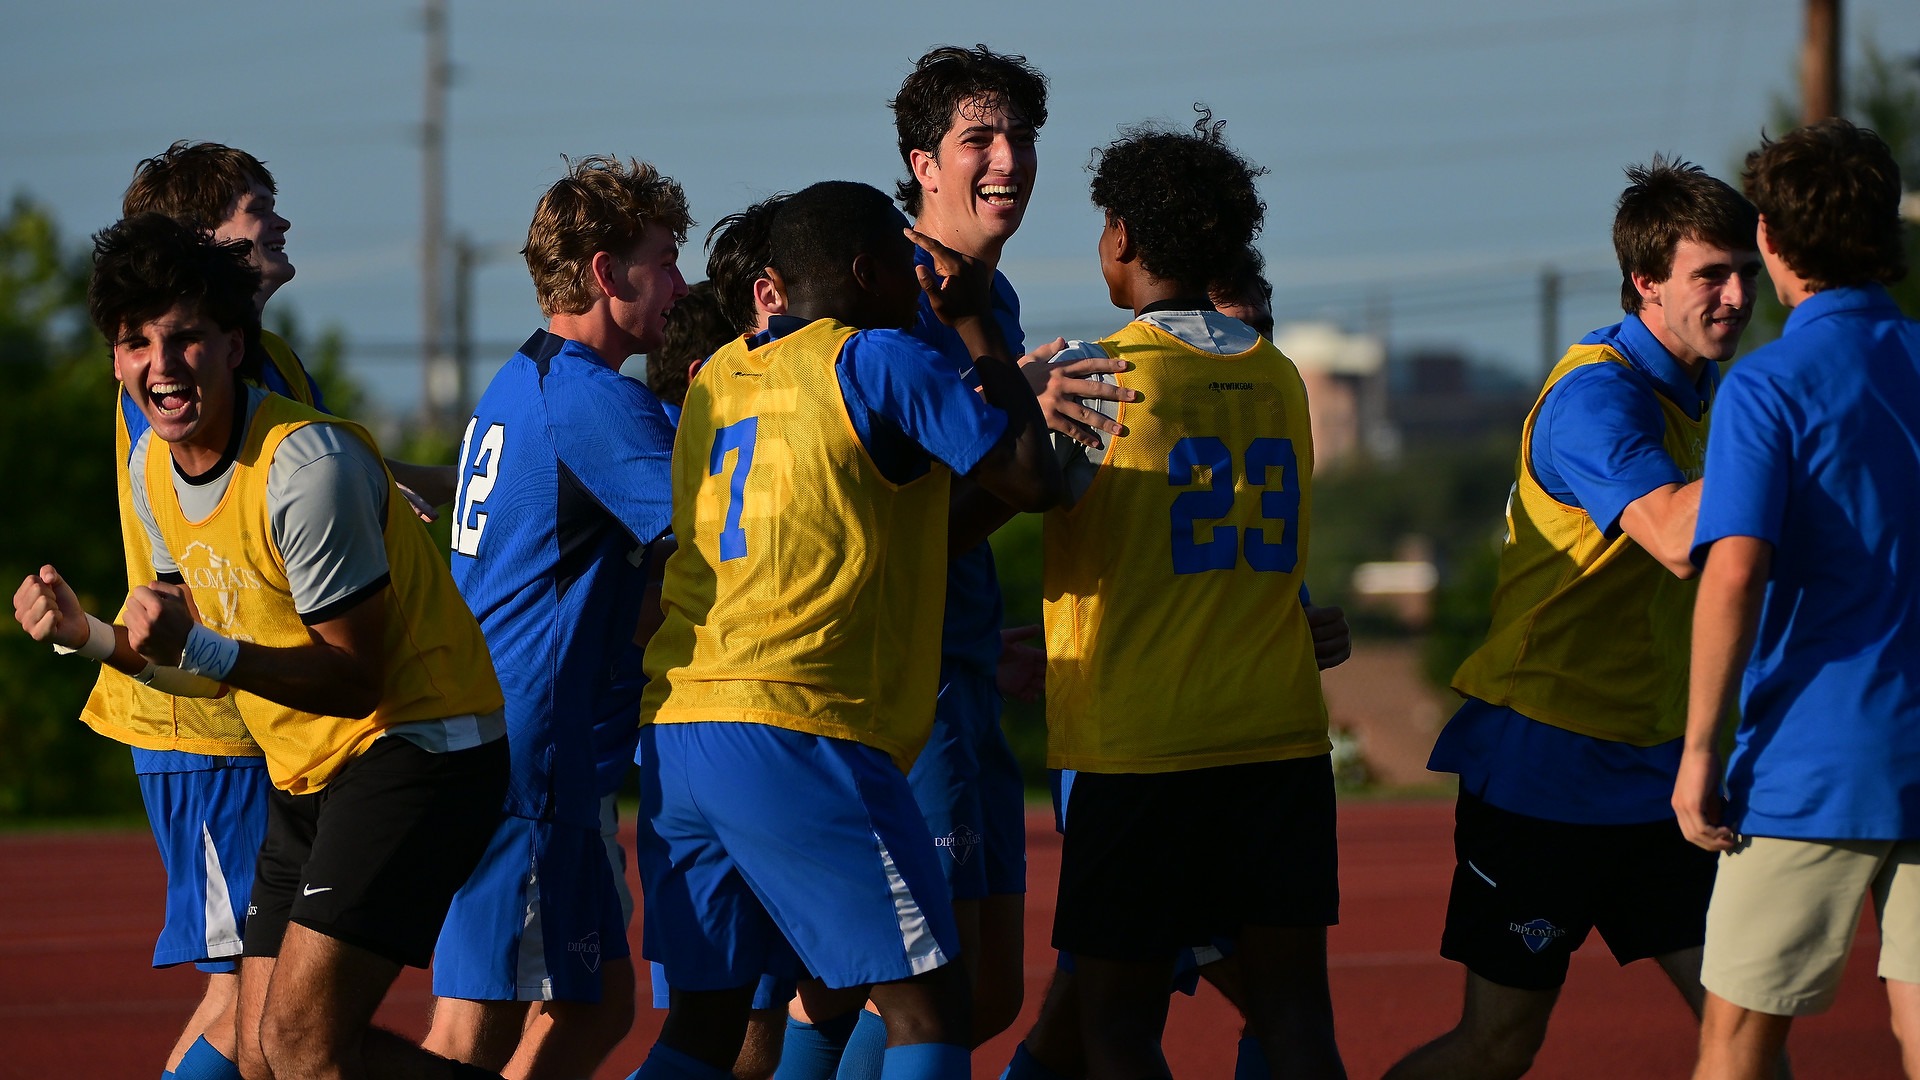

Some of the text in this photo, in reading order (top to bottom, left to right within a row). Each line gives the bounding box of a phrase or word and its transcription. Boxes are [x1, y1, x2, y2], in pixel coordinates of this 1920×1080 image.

[451, 415, 505, 559] 12
[709, 416, 758, 562] 7
[1168, 436, 1300, 575] 23
[176, 563, 261, 591] LOMATS
[934, 833, 981, 847] DIPLOMATS
[1509, 922, 1566, 937] DIPLOMATS
